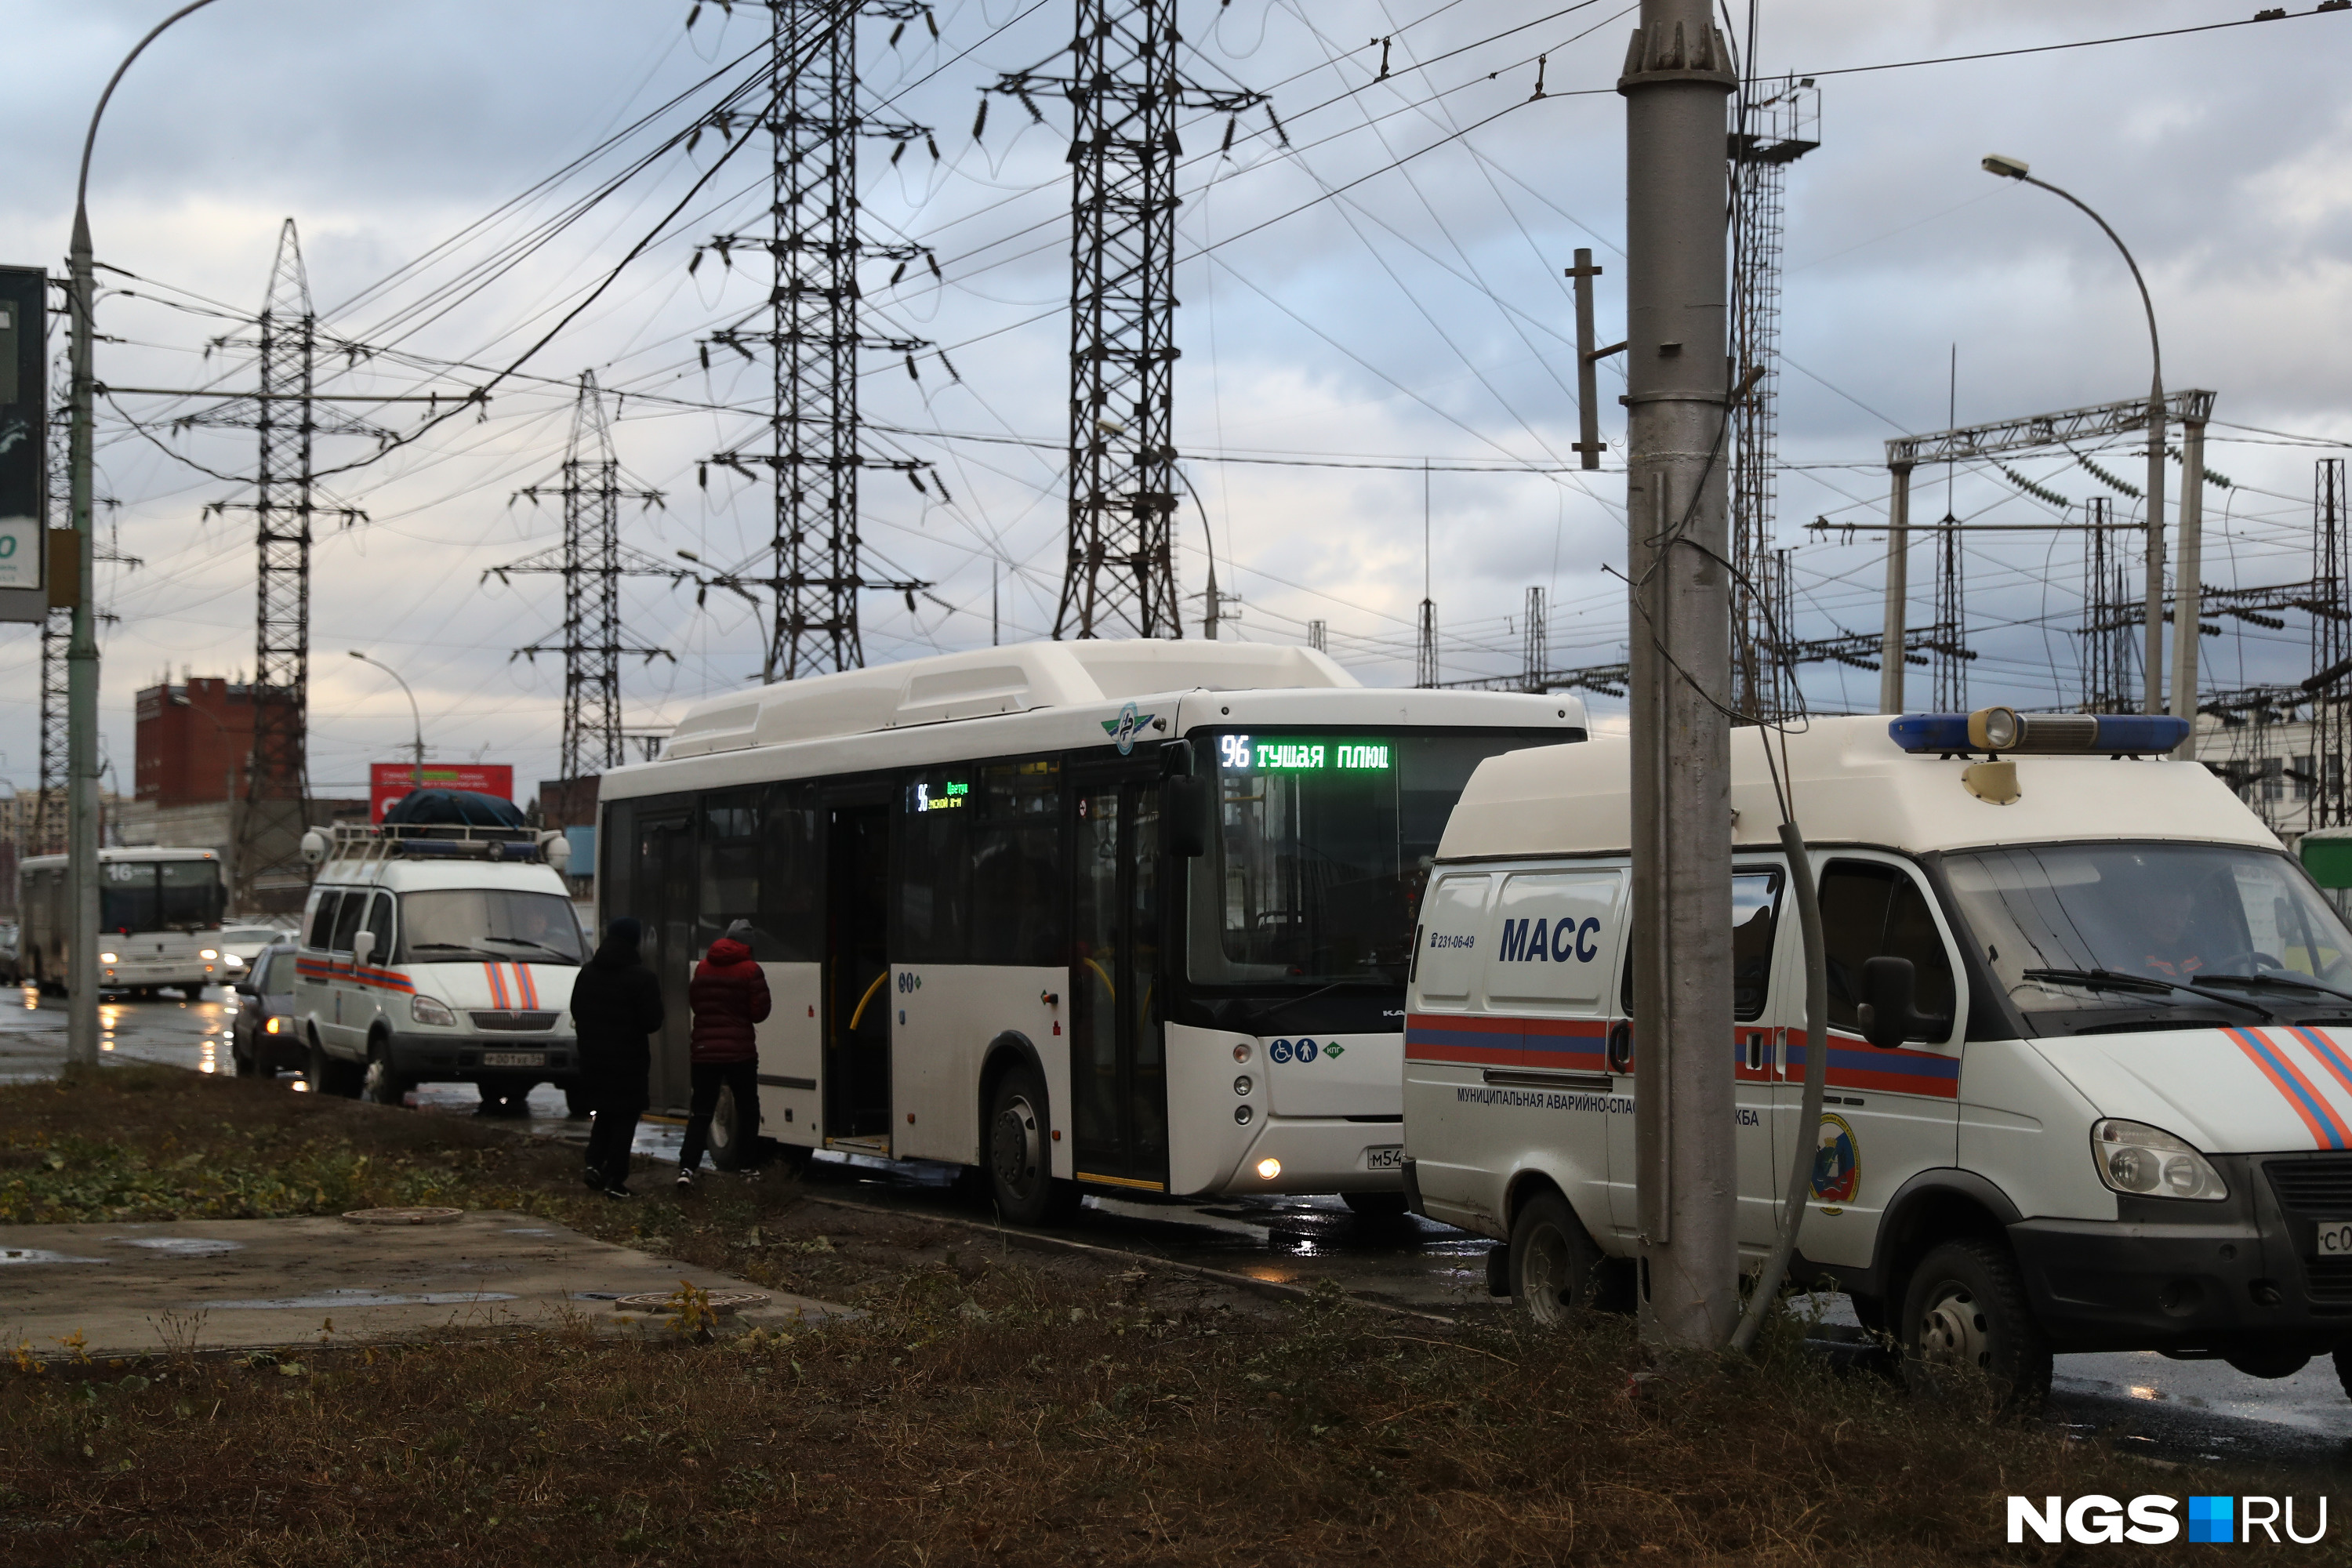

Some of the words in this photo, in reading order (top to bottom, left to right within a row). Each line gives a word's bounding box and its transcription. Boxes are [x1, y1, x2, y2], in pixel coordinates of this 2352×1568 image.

[1221, 735, 1250, 768] 96
[106, 863, 132, 881] 16
[1437, 935, 1475, 949] 231-06-49
[1499, 917, 1601, 963] МАСС
[1457, 1088, 1544, 1108] МУНИЦИПАЛЬНАЯ
[1546, 1093, 1636, 1115] АВАРИЙНО-СПА
